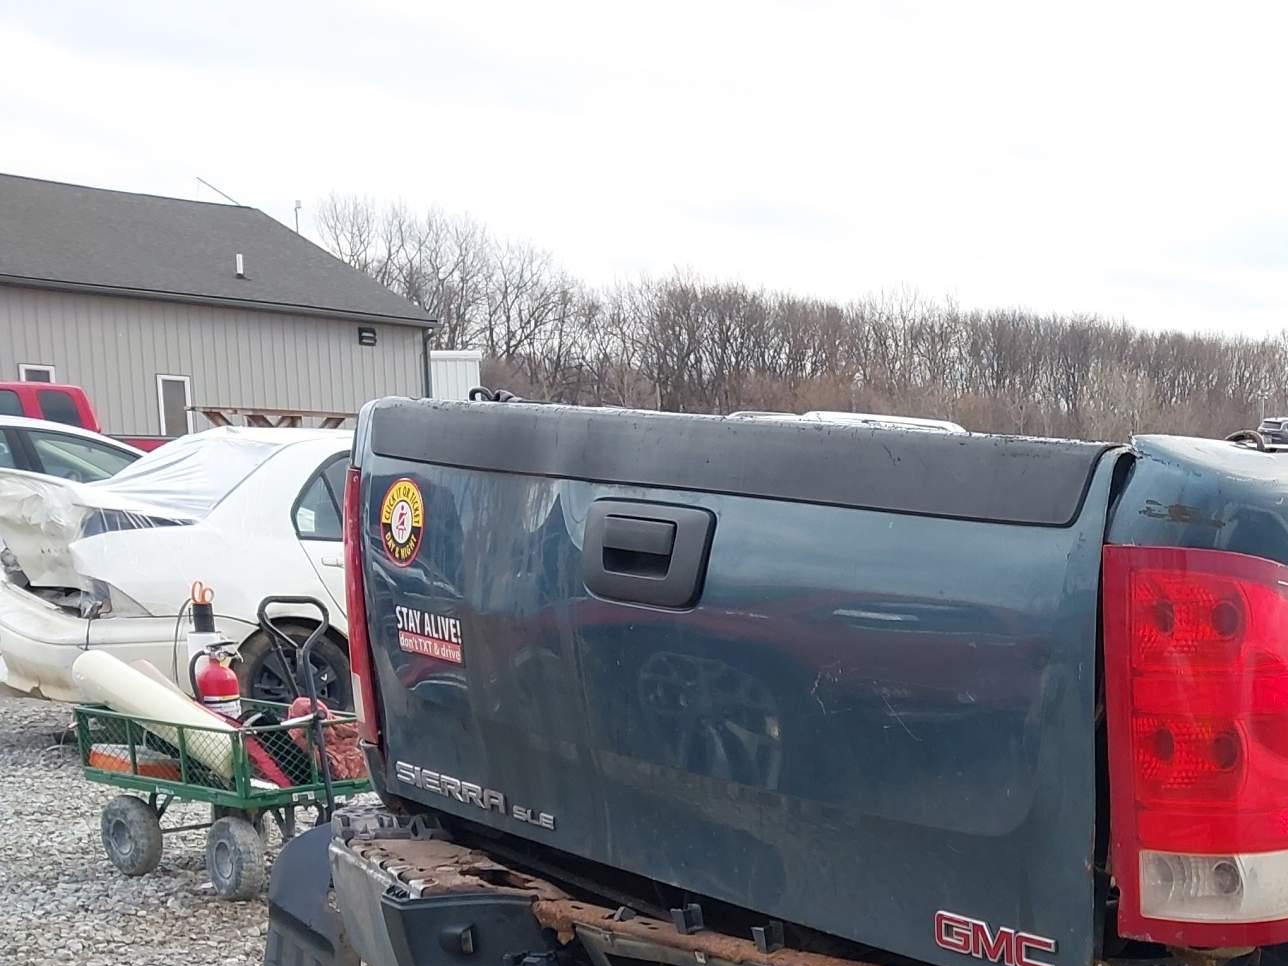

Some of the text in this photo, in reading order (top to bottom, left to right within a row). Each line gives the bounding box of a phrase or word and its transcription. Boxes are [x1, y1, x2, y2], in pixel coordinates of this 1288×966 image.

[395, 605, 462, 645] STAY ALIVE!
[400, 634, 418, 650] don't
[418, 639, 432, 653] TXT
[440, 644, 462, 661] drive
[396, 760, 556, 830] SIERRA SLE
